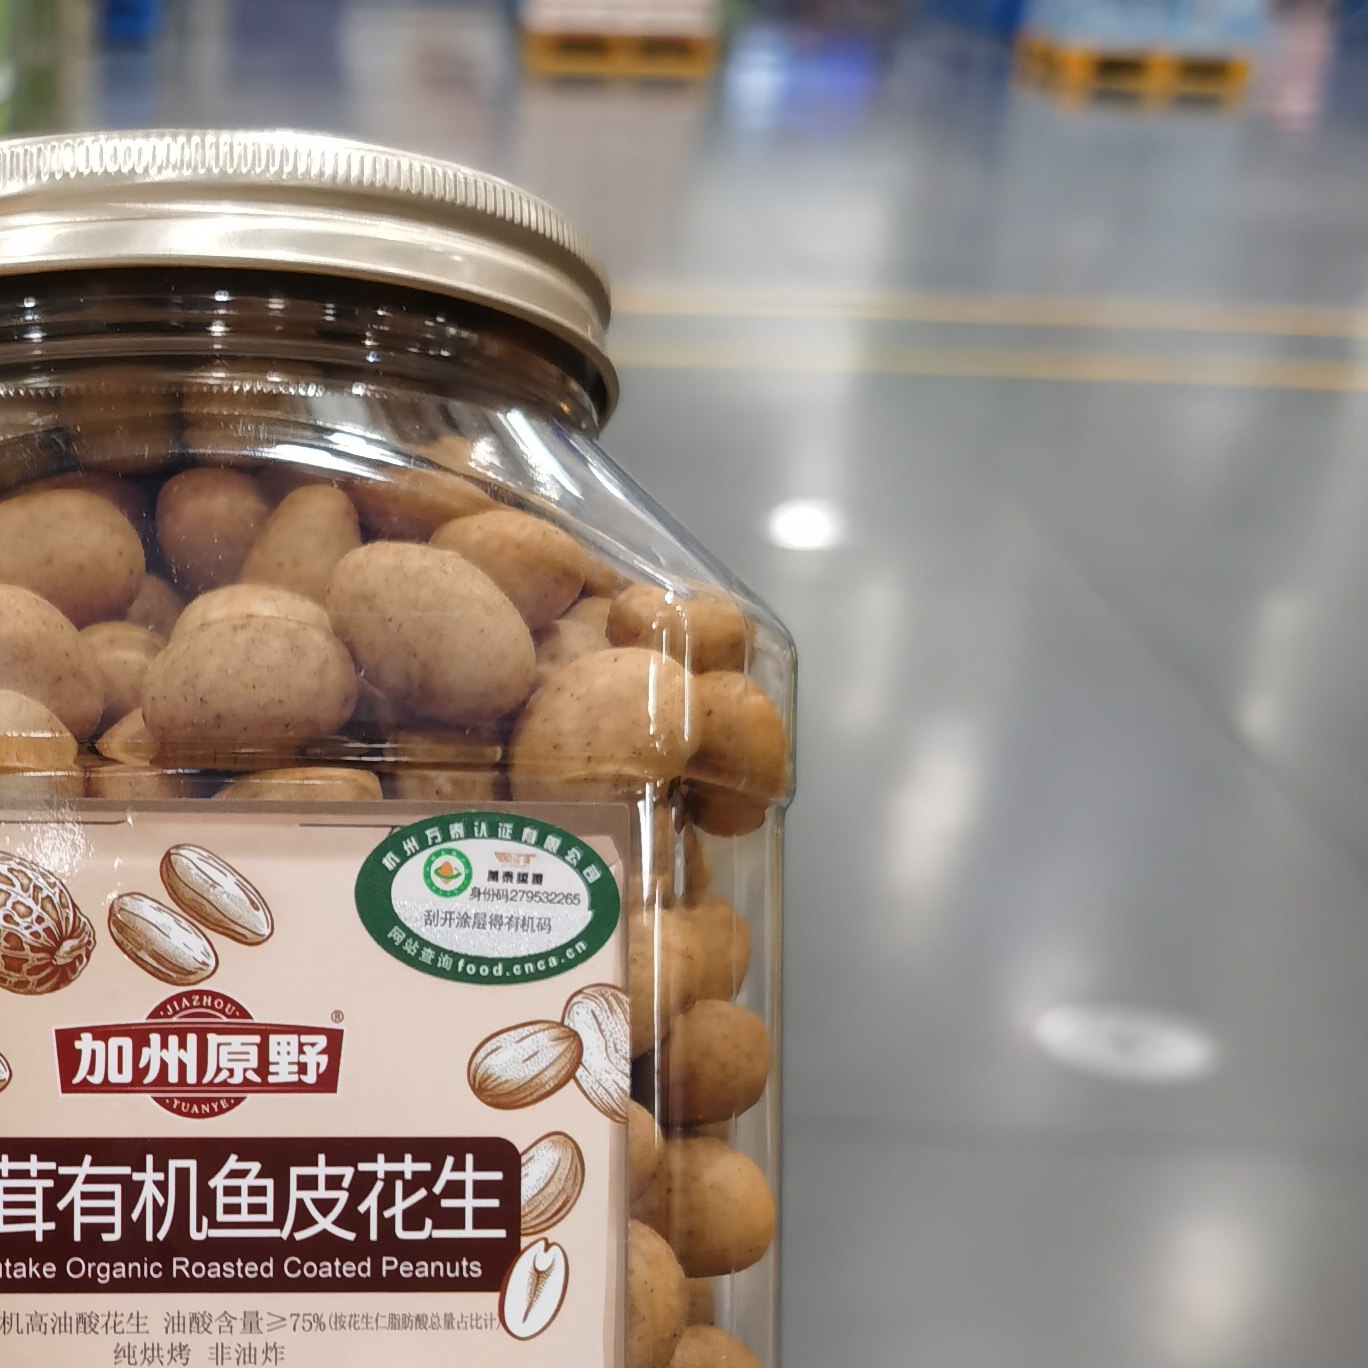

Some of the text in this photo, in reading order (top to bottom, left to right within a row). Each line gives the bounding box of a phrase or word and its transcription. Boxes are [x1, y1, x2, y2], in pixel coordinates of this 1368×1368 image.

[469, 886, 581, 906] 身份码279532265
[424, 909, 552, 934] 刮开涂层得有机码
[167, 995, 235, 1016] JIAZHOU
[72, 1032, 329, 1084] 加州原野
[171, 1098, 230, 1114] YUANYE
[66, 1257, 163, 1284] Organic
[173, 1256, 274, 1279] Roasted
[283, 1256, 371, 1278] Coated
[382, 1256, 483, 1278] Peanuts
[113, 1341, 285, 1367] 纯烘烤 非油炸
